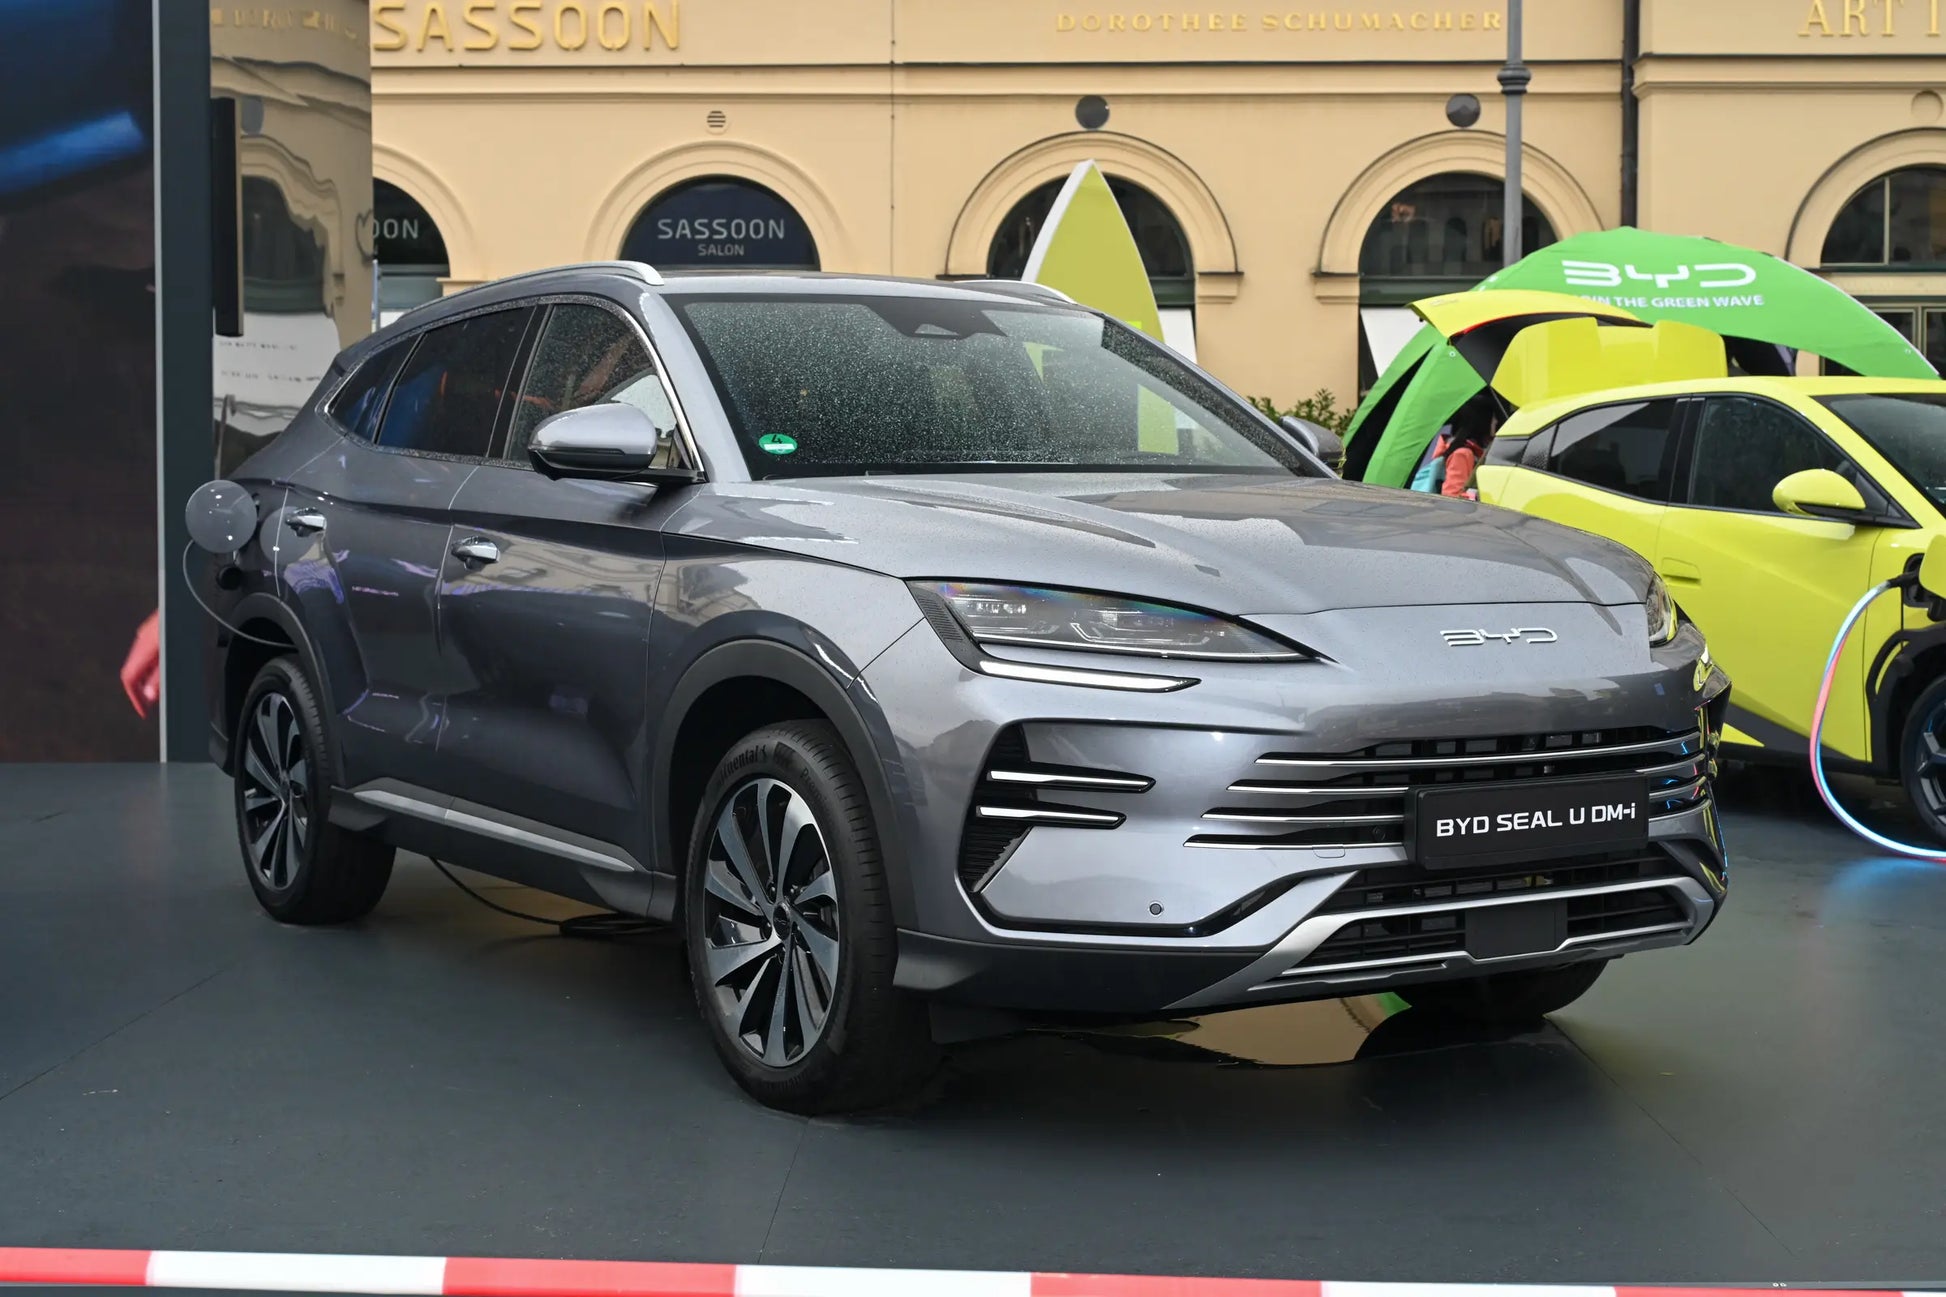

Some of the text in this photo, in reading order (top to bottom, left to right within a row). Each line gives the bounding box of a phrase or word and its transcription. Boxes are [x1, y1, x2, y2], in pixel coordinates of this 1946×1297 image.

[373, 0, 680, 51] SASSOON
[1056, 11, 1501, 32] DOROTHEE SCHUMACHER
[1797, 0, 1905, 37] ART
[657, 218, 785, 239] SASSOON
[697, 243, 744, 256] SALON
[1561, 260, 1756, 288] BYD
[1613, 296, 1648, 308] THE
[1651, 297, 1710, 308] GREEN
[1712, 295, 1765, 308] WAVE
[771, 434, 783, 444] 4
[1440, 627, 1558, 647] BYD
[1436, 802, 1636, 837] BYD SEAL U DM-i
